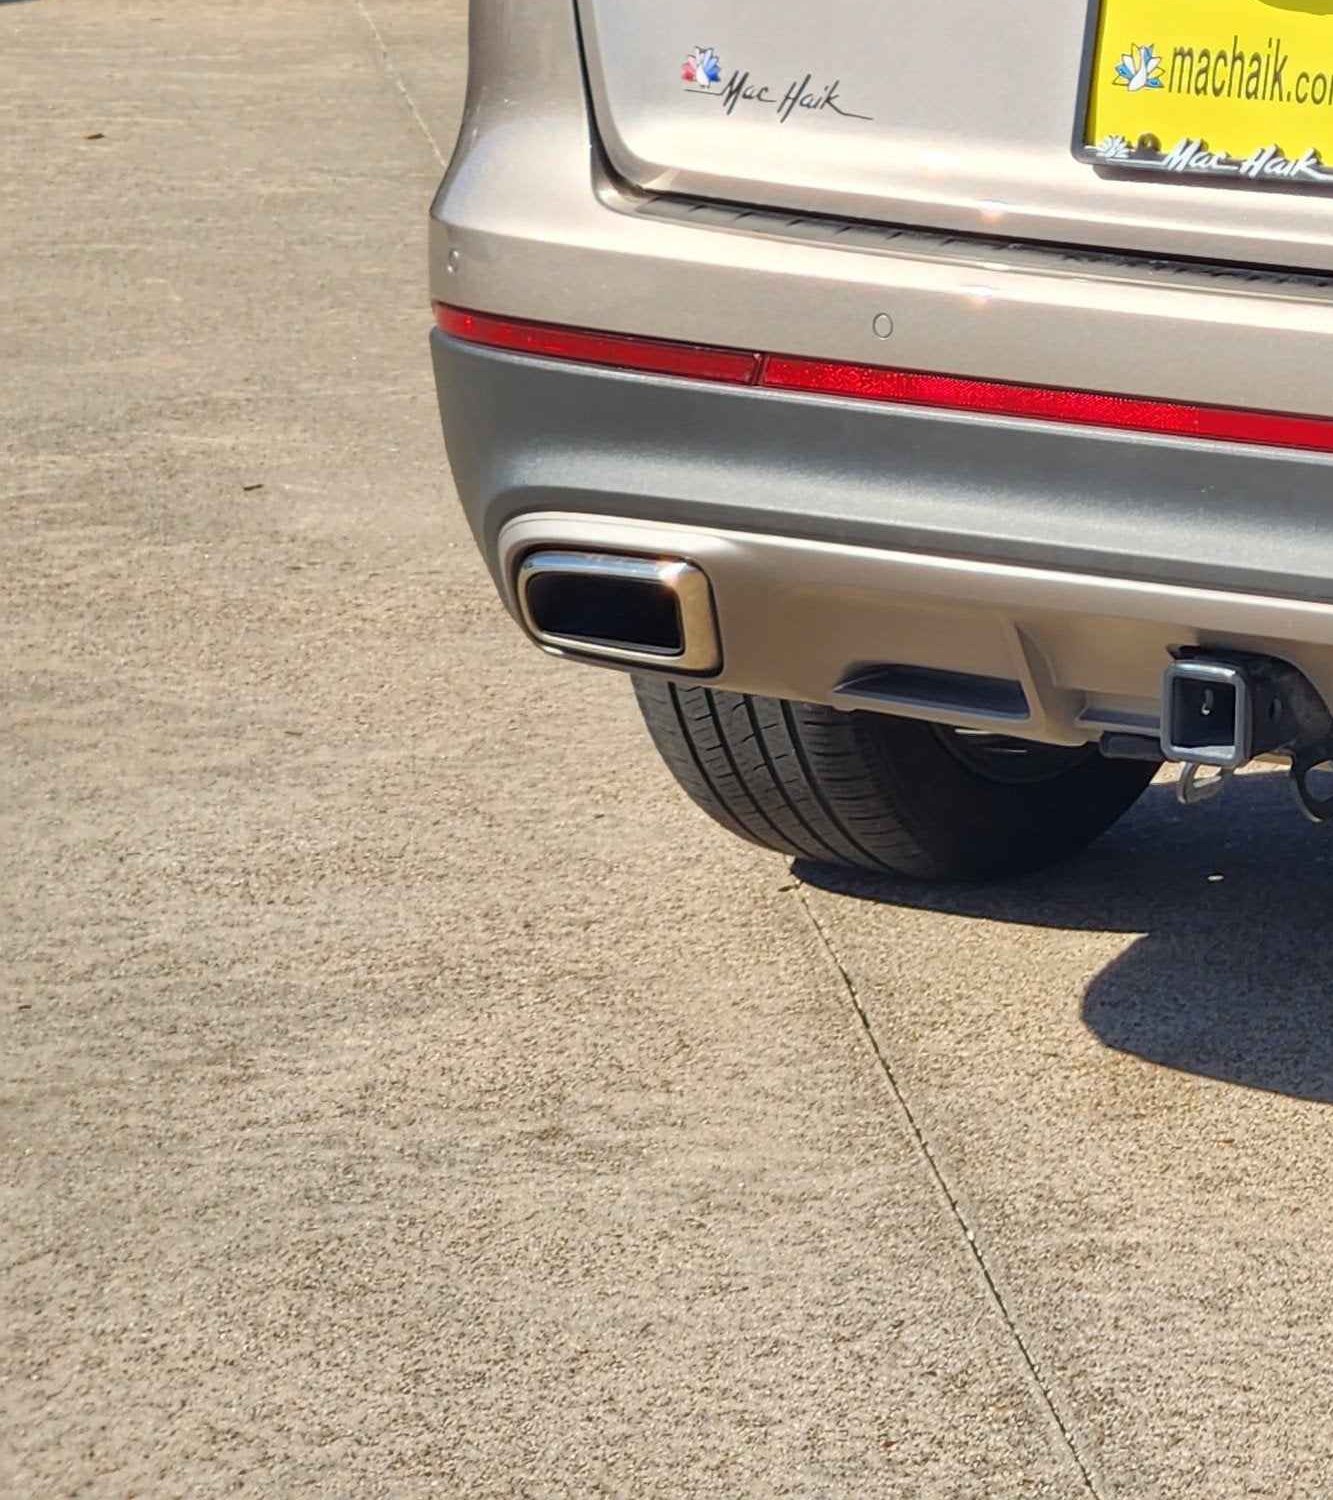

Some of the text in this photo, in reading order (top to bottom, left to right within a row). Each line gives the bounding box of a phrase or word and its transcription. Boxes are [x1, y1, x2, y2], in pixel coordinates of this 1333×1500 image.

[720, 69, 875, 123] Mac Haik
[1161, 136, 1239, 173] Mac
